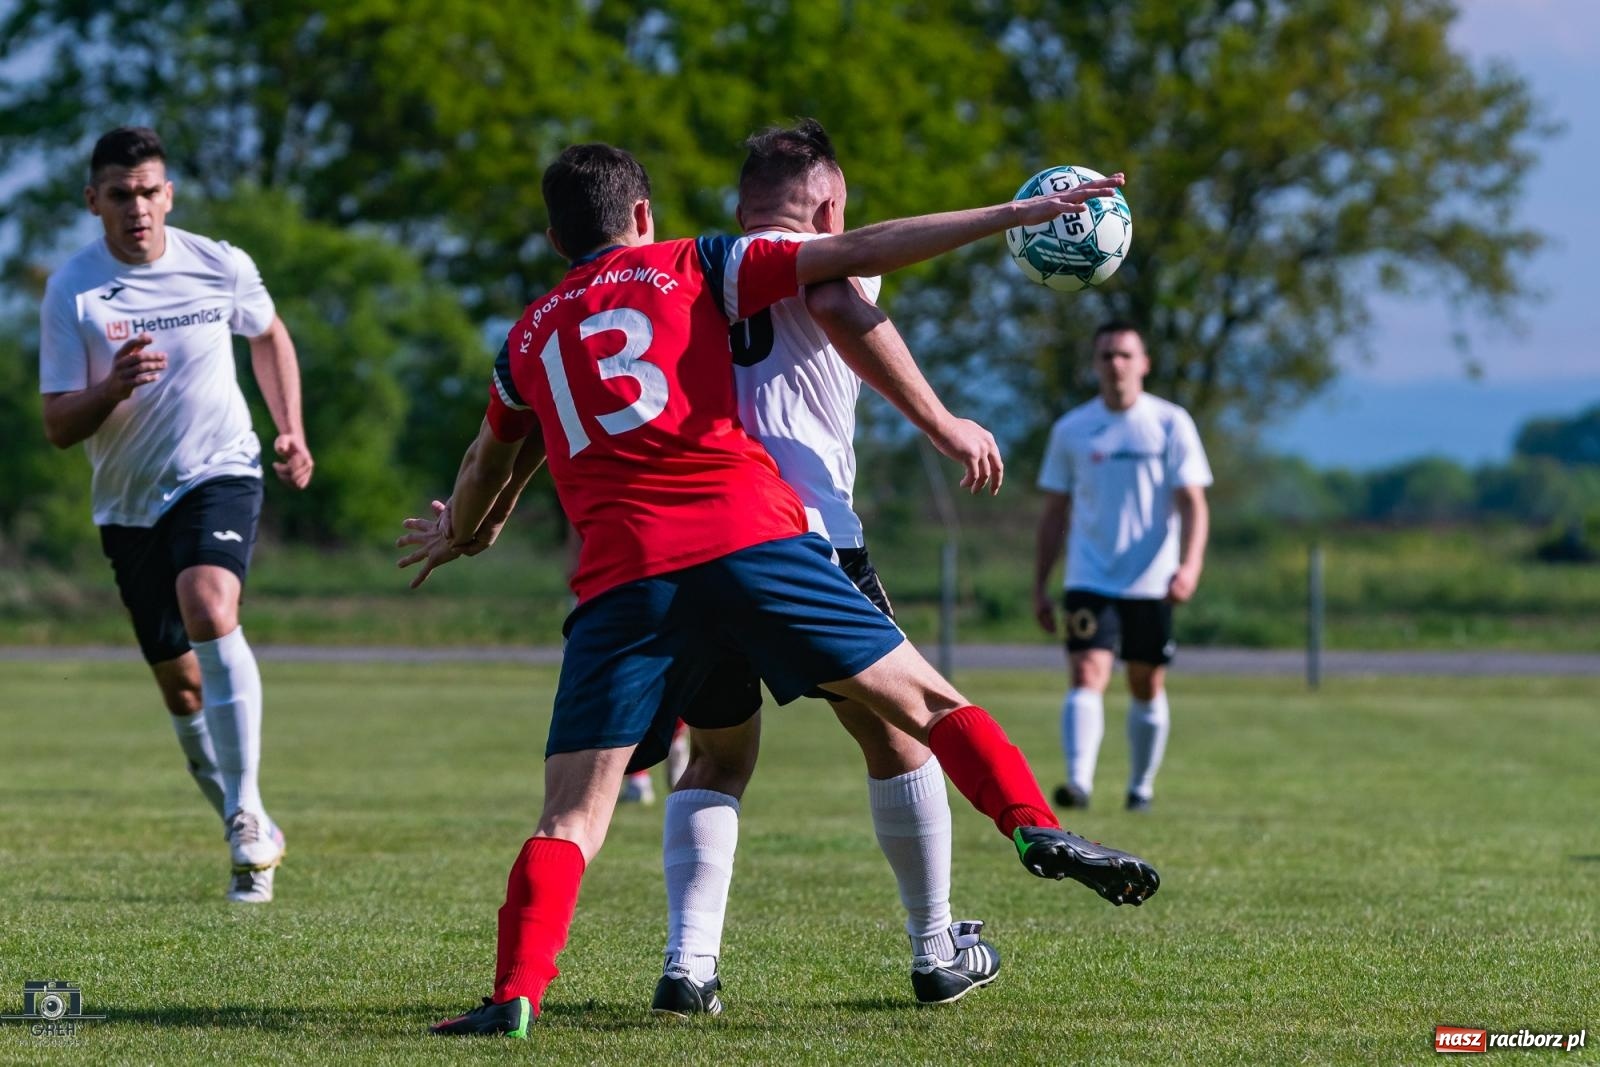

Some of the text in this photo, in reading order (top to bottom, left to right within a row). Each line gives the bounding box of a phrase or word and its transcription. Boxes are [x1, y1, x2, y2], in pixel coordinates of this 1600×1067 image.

[1050, 175, 1085, 237] SECT
[519, 266, 679, 354] KS 1905 KRANOWICE
[538, 307, 670, 459] 13
